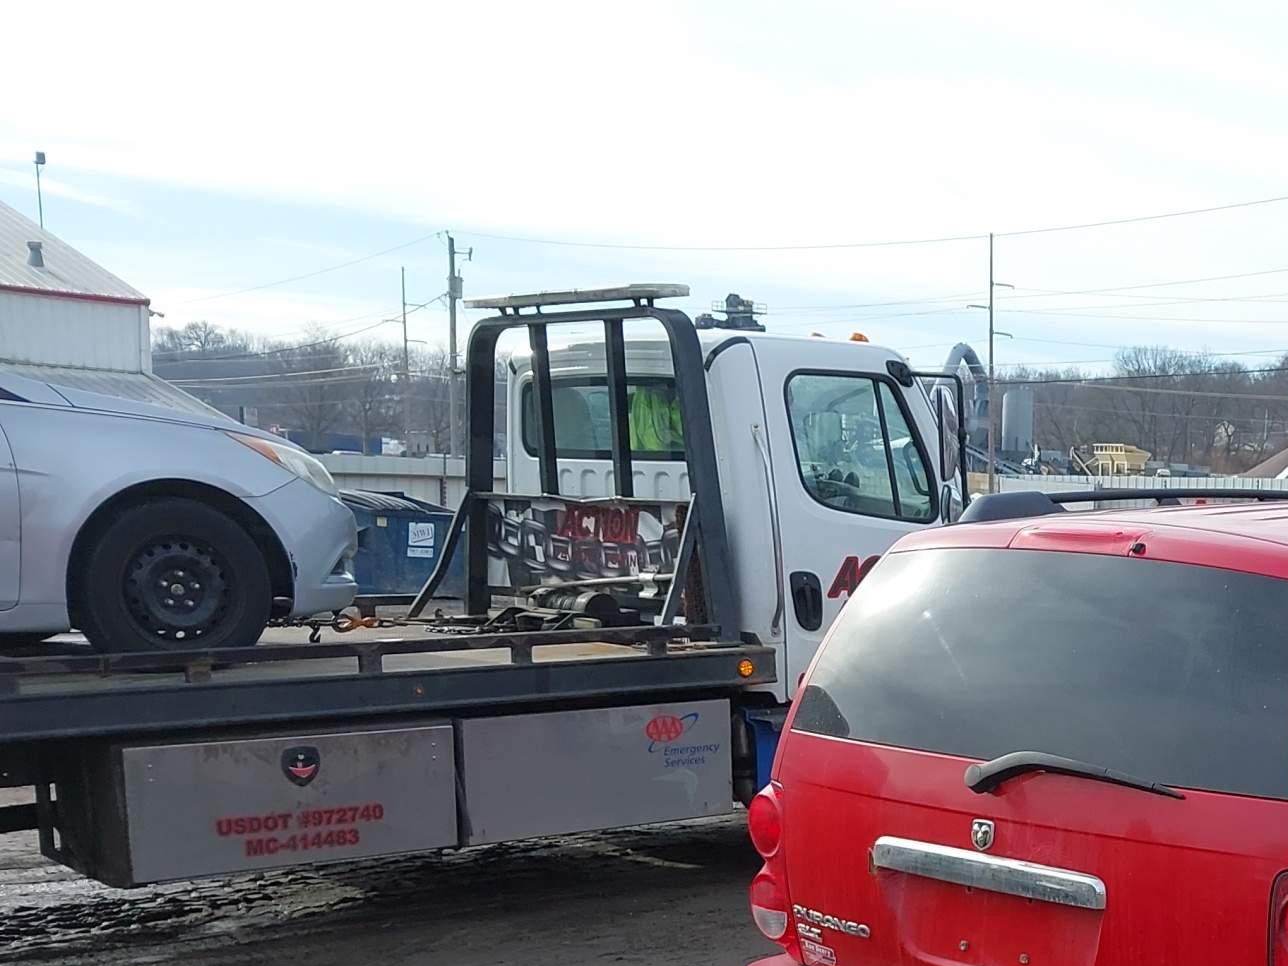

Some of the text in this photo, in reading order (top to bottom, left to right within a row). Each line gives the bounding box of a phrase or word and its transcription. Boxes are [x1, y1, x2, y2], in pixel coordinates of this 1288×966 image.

[646, 715, 684, 741] AAA
[663, 743, 720, 757] Emergency
[663, 756, 705, 768] Services
[216, 803, 384, 837] USDOT #972740
[793, 904, 871, 938] DURANGO
